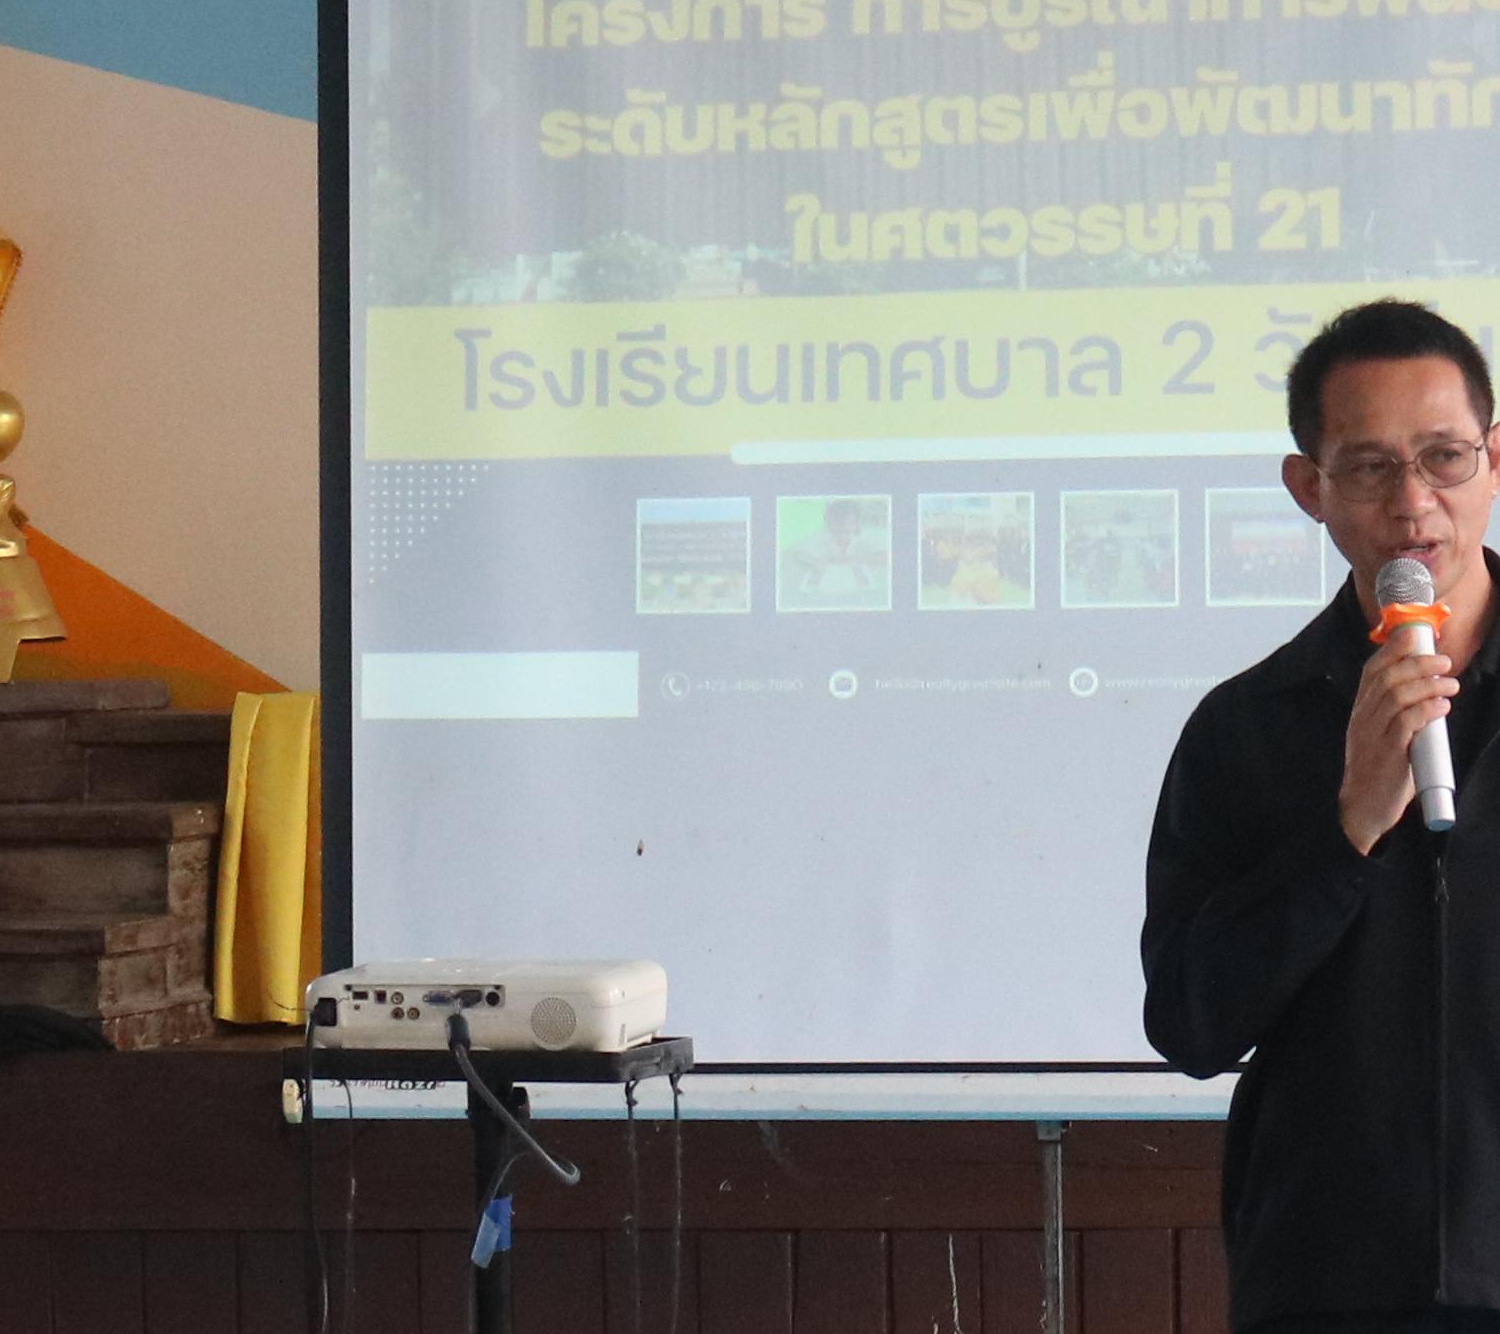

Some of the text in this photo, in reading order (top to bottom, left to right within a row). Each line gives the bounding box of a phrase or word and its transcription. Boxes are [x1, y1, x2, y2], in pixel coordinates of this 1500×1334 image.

[784, 162, 1343, 264] ในศตวรรษที่ 21
[452, 324, 1124, 412] โรงเรียนเทศบาล
[1160, 319, 1216, 395] 2
